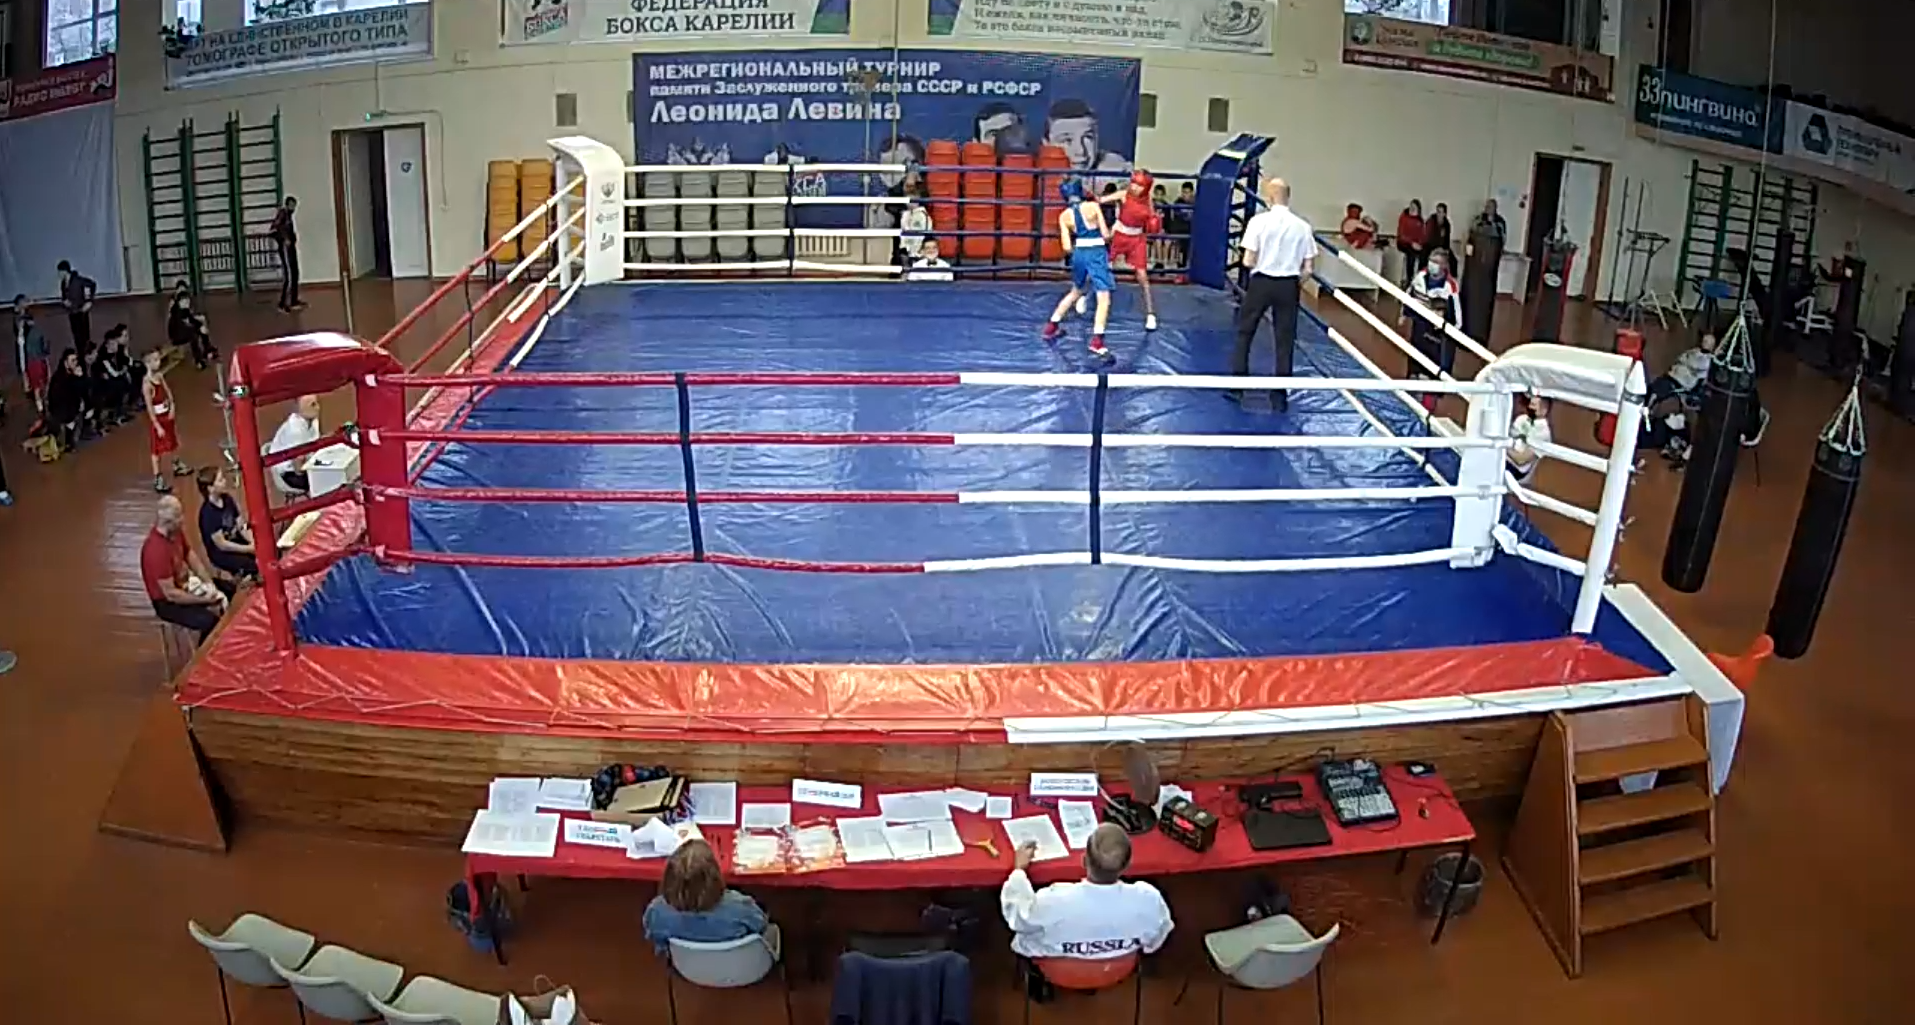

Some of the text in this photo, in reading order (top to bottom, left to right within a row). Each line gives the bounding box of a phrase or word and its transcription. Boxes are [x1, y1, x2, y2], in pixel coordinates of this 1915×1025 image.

[631, 0, 769, 12] ФЕДЕРАЦИЯ
[606, 12, 795, 35] БОКСА КАРЕЛИИ
[270, 28, 361, 53] ОТКРЫТОГО
[365, 22, 409, 40] ТИПА
[650, 57, 941, 80] МЕЖРЕГИОНАЛЬНЫЙ ТУРНИР
[714, 81, 838, 96] Заслуженного
[917, 80, 963, 94] СССР
[966, 83, 978, 94] и
[982, 81, 1042, 95] РСФСР
[651, 97, 901, 124] Леонида Левина
[1061, 937, 1141, 954] RUSSIA
